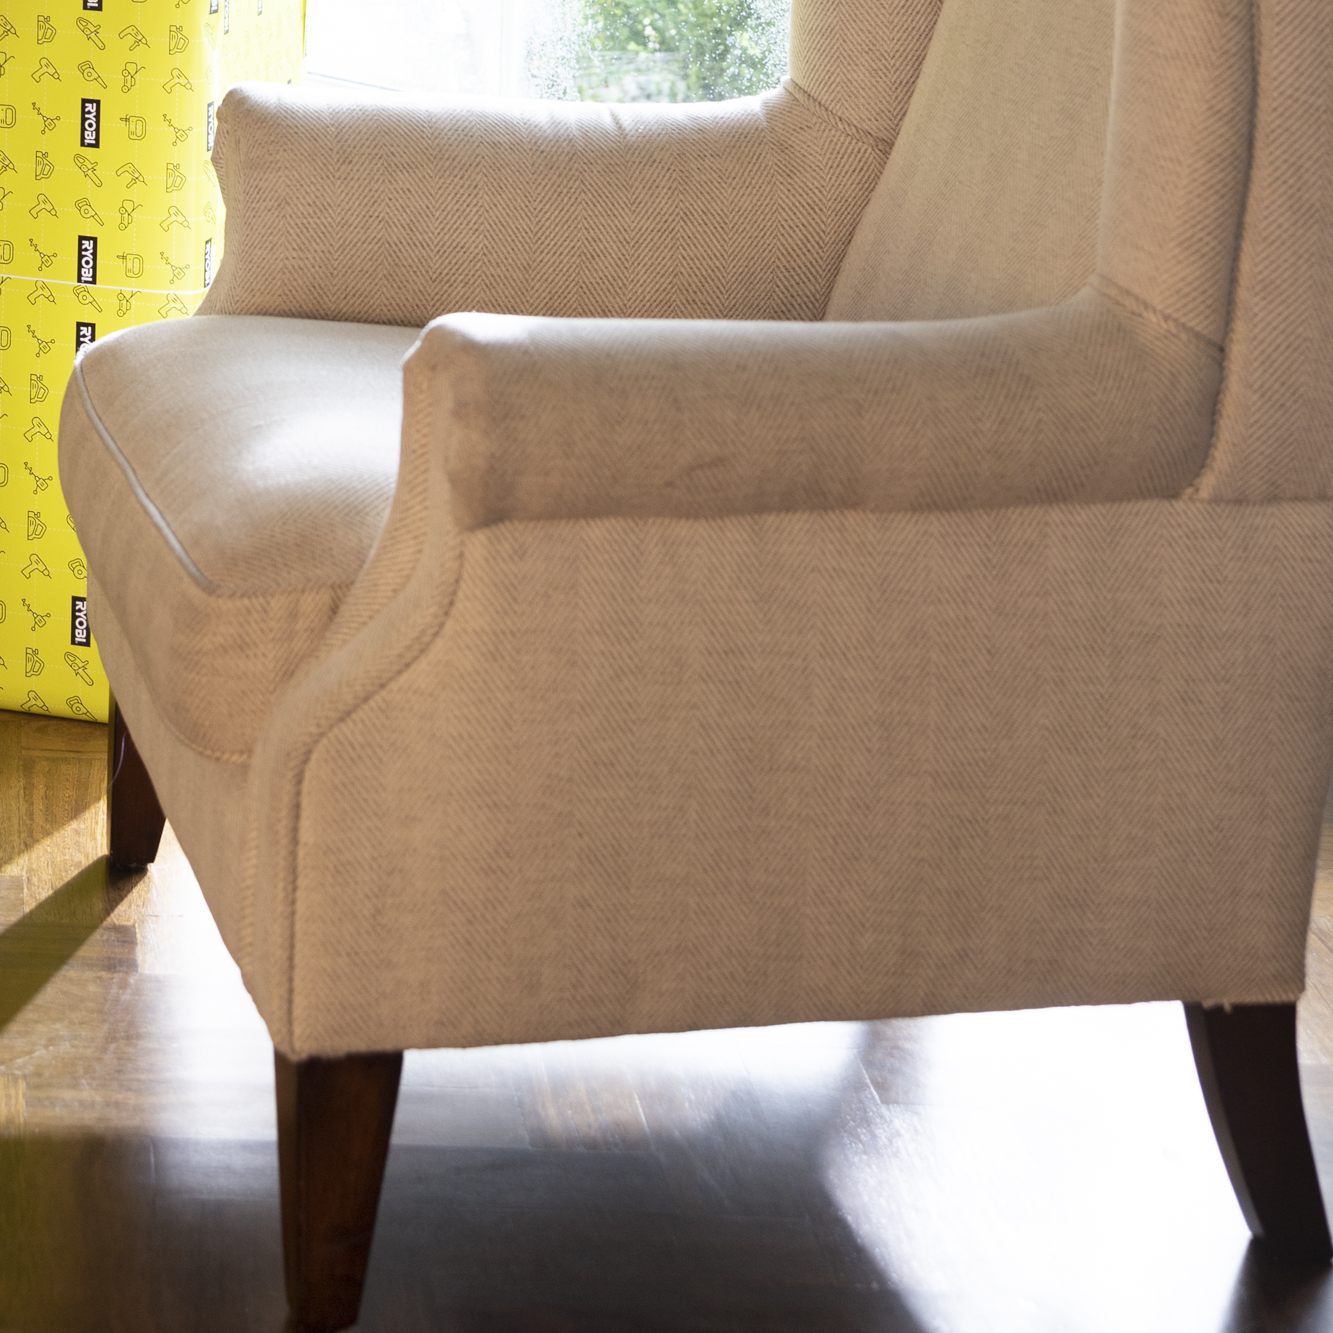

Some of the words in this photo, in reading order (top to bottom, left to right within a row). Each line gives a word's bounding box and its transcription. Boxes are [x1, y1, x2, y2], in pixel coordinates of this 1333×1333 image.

[84, 102, 97, 146] RYOBI
[80, 239, 94, 283] RYOBI
[74, 600, 88, 644] RYOBI
